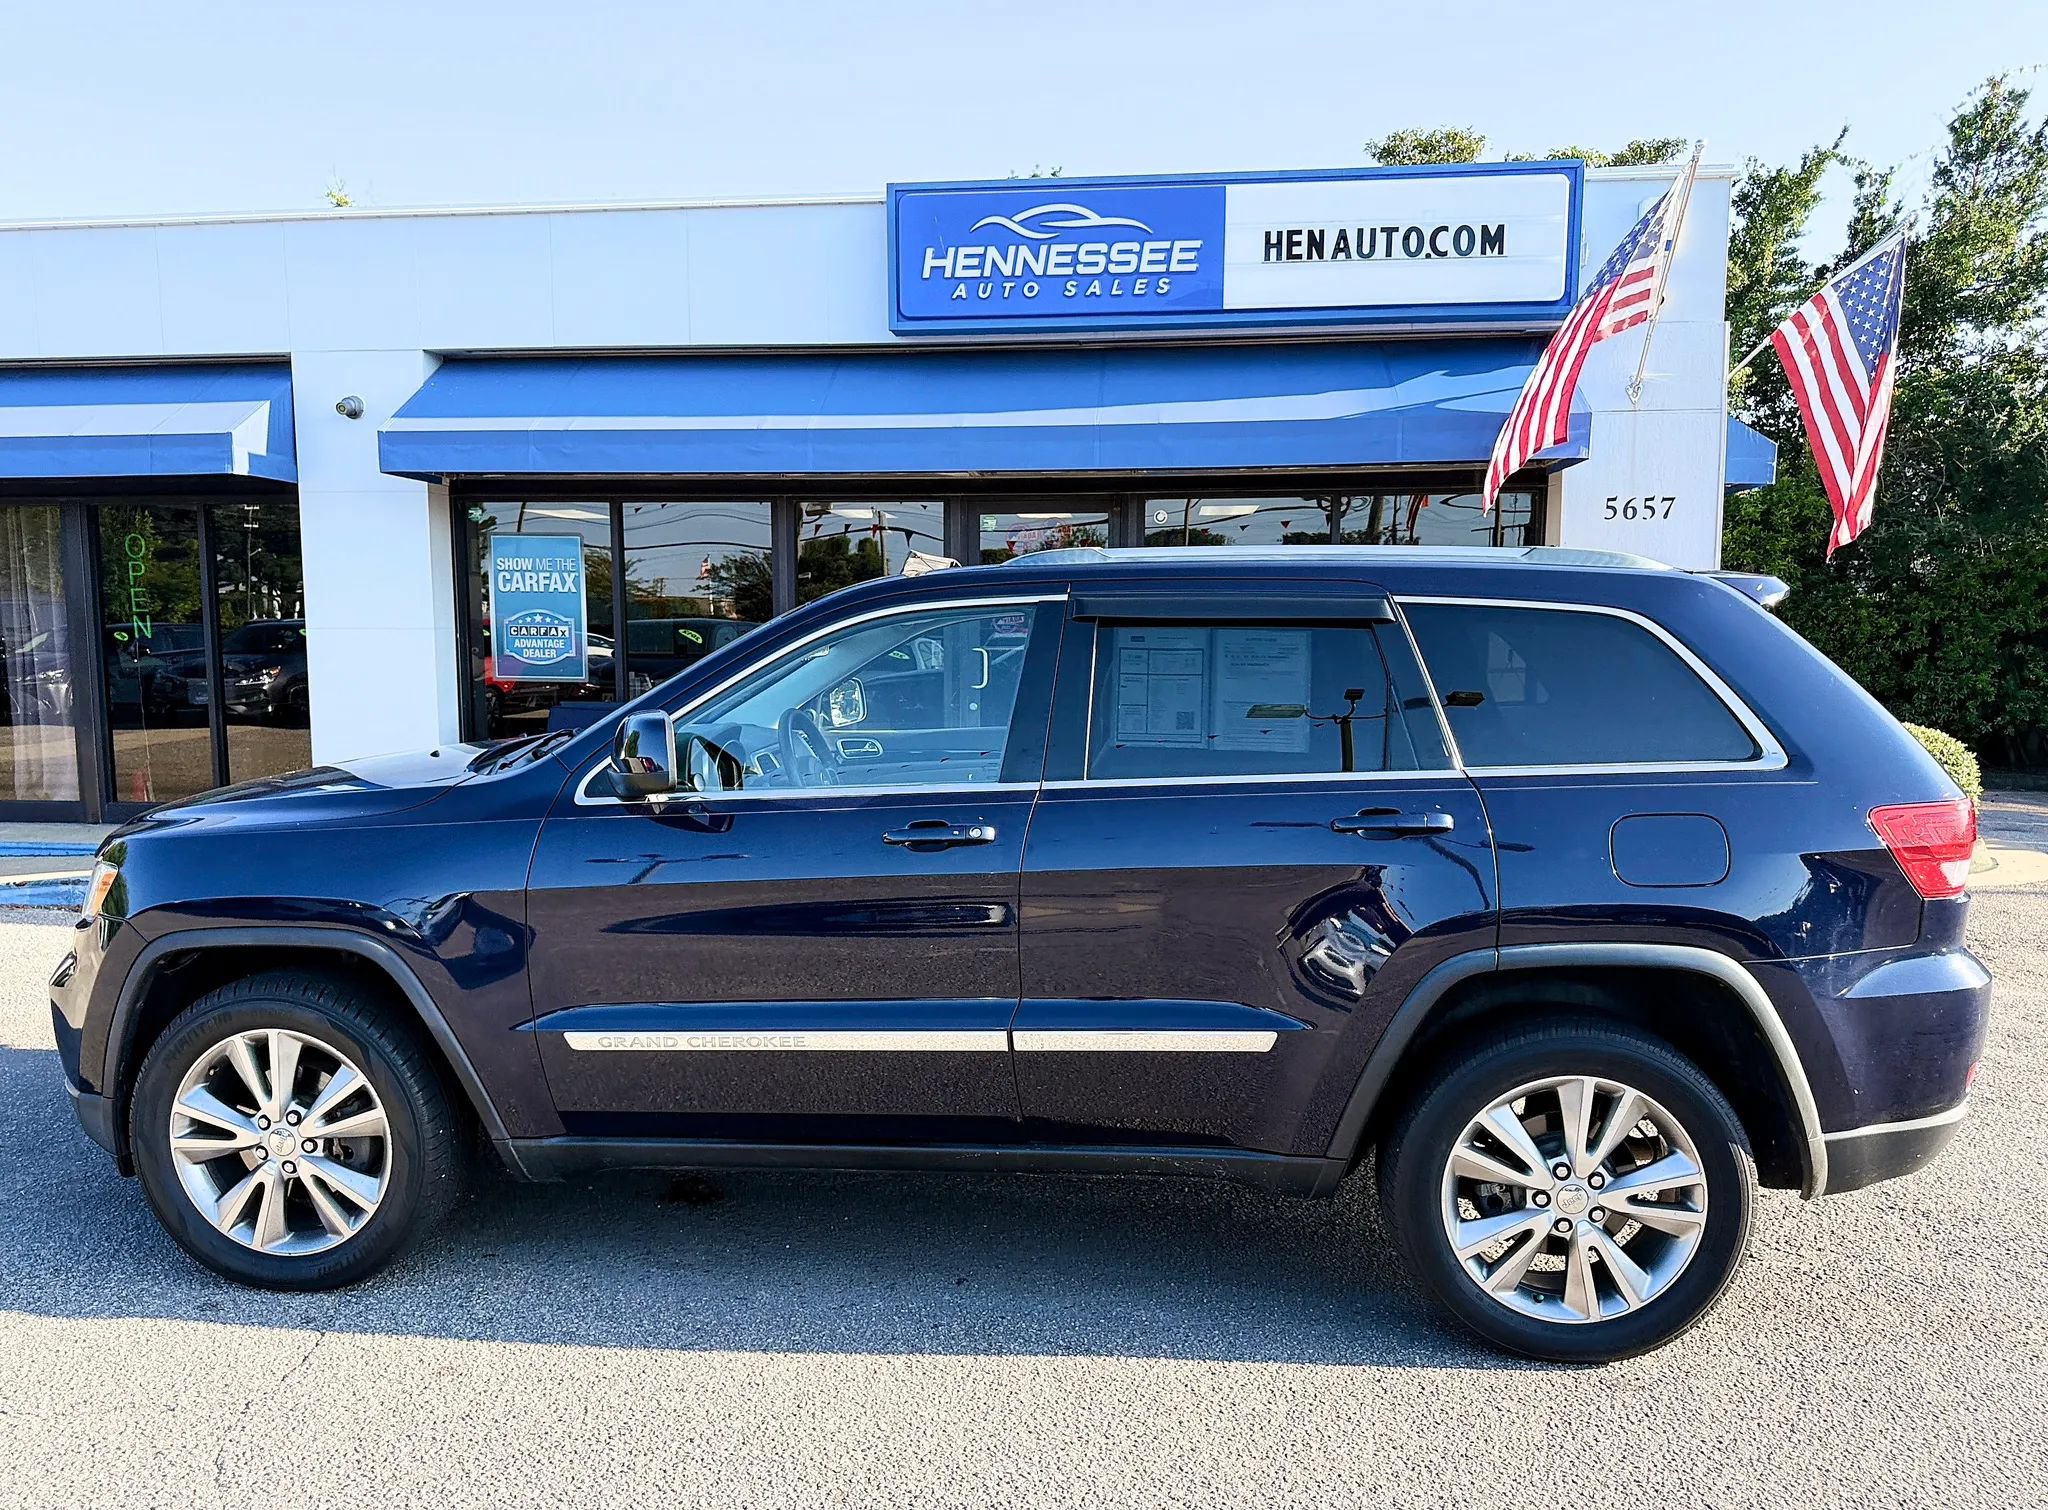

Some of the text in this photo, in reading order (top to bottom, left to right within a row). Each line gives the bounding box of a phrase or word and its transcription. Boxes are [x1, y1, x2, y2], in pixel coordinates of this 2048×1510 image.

[1263, 223, 1506, 261] HENAUTO.COM
[922, 240, 1203, 279] HENNESSEE
[952, 277, 1171, 299] AUTO SALES
[1604, 495, 1676, 520] 5657
[496, 558, 576, 571] SHOW ME THE
[125, 533, 152, 639] OPEN
[497, 571, 578, 593] CARFAX
[510, 626, 567, 637] CARFAX
[513, 639, 565, 648] ADVANTAGE
[523, 649, 557, 658] DEALER
[598, 1036, 806, 1048] GRAND CHEROKEE
